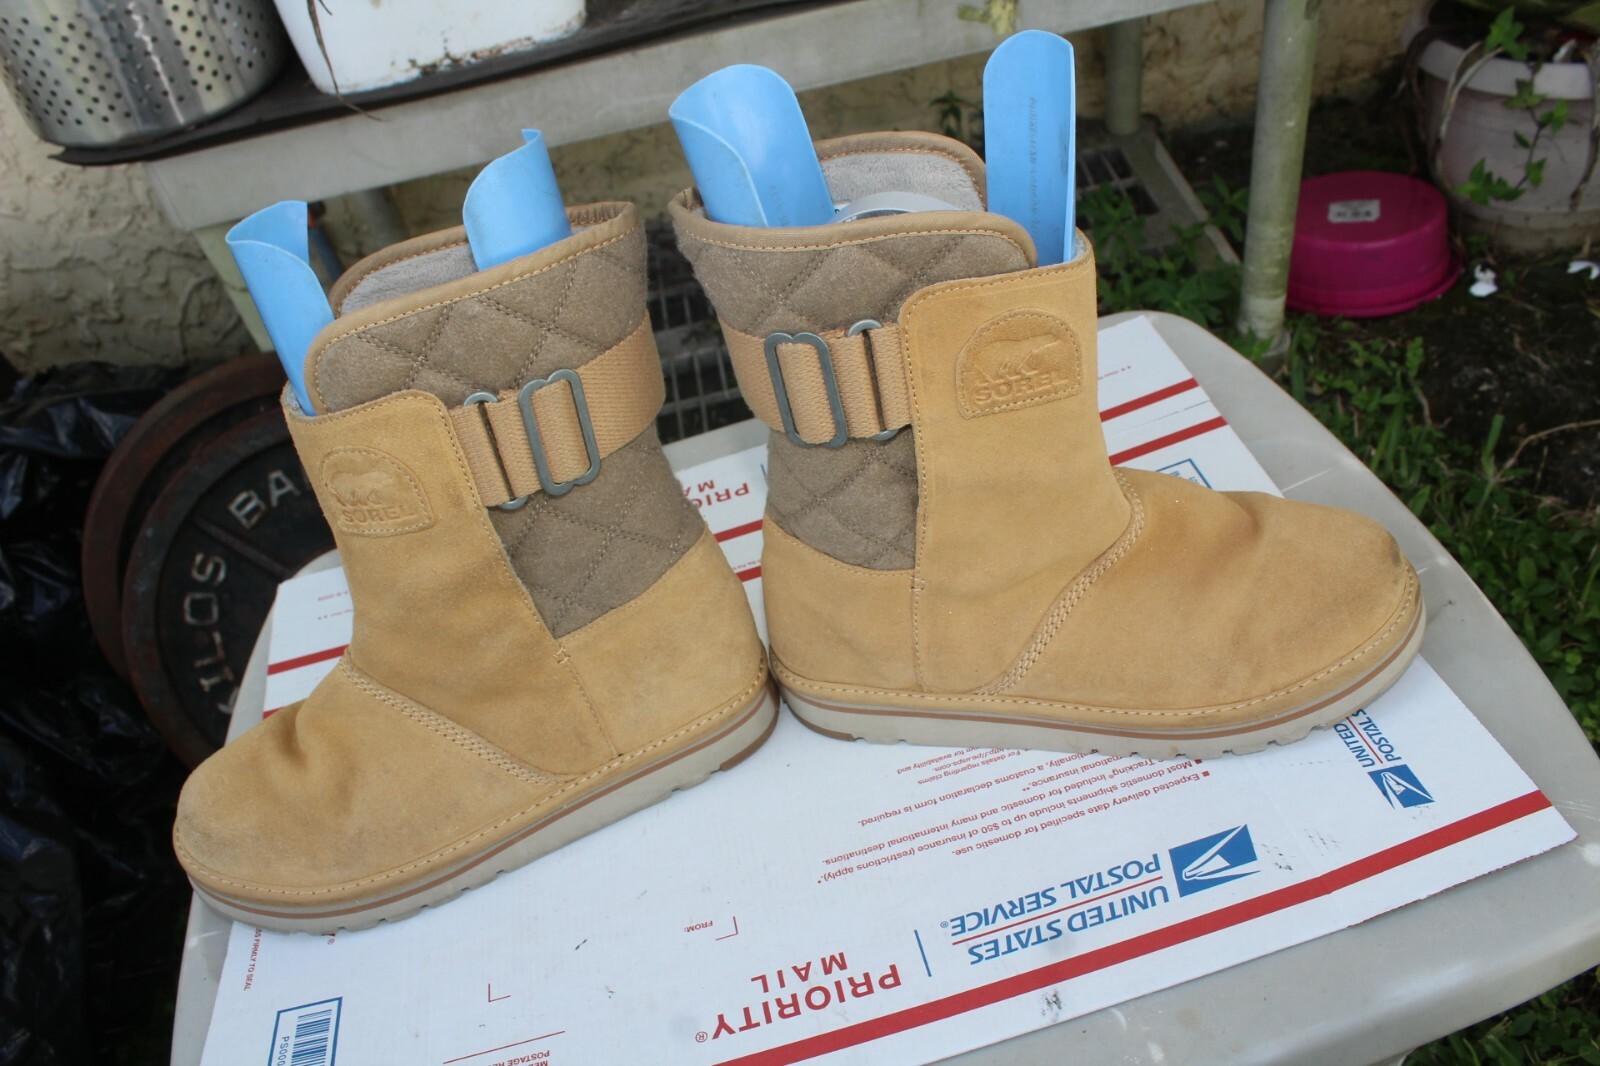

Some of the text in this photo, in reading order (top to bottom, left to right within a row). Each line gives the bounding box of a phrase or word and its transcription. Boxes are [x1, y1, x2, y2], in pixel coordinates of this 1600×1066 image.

[974, 370, 1069, 404] SOREL
[342, 504, 415, 523] SOREL
[1334, 723, 1375, 767] UNITED
[1359, 717, 1402, 762] POSTAL
[913, 753, 952, 768] availability
[981, 754, 1006, 765] details
[1166, 761, 1192, 773] Most
[897, 766, 912, 774] and
[944, 762, 979, 777] regarding
[994, 768, 1035, 784] customs
[918, 774, 942, 785] claims
[1064, 774, 1106, 792] included
[1120, 770, 1164, 788] domestic
[939, 781, 992, 801] declaration
[1048, 788, 1062, 796] for
[1067, 785, 1118, 805] shipments
[914, 798, 938, 809] form
[1001, 794, 1046, 811] domestic
[1029, 802, 1066, 817] include
[858, 809, 902, 827] required.
[952, 774, 1200, 855] Expected delivery date specified for domestic use.
[952, 814, 978, 827] many
[980, 808, 998, 819] and
[1014, 814, 1027, 822] up
[888, 824, 949, 847] international
[968, 829, 978, 838] of
[981, 823, 1000, 834] $50
[918, 833, 966, 851] insurance
[822, 843, 885, 865] destinations.
[856, 848, 915, 870] (restrictions
[1060, 853, 1161, 899] POSTAL
[684, 920, 713, 933] FROM:
[968, 886, 1169, 965] UNITED STATES
[250, 939, 260, 962] FIRMLY
[248, 964, 255, 972] TO
[751, 952, 848, 993] MAIL
[244, 974, 253, 991] SEAL
[507, 1050, 550, 1065] POSTAGE
